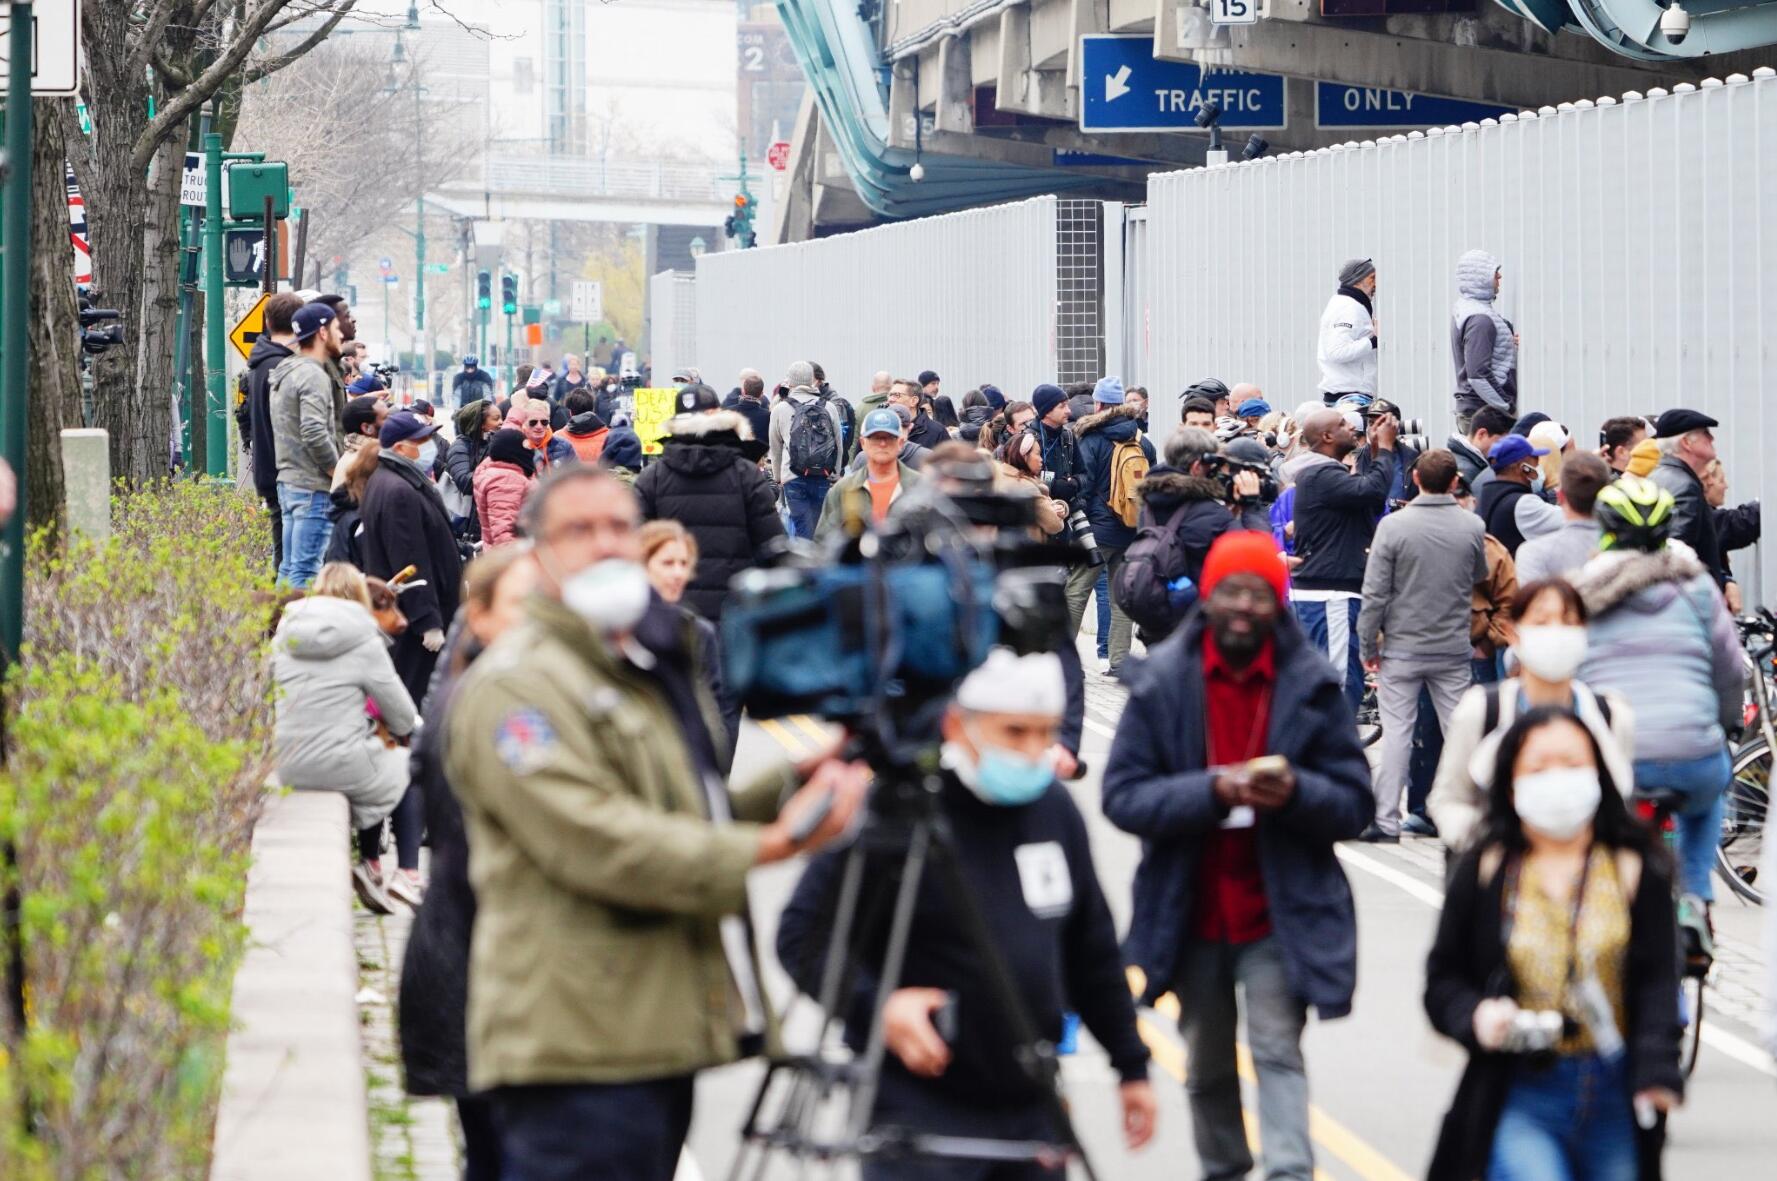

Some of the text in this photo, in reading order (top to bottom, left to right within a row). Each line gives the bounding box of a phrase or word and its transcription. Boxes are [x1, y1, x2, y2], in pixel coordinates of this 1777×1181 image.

[1219, 0, 1247, 17] 15
[1155, 89, 1262, 112] TRAFFIC
[1344, 87, 1415, 112] ONLY
[184, 174, 207, 186] TRU
